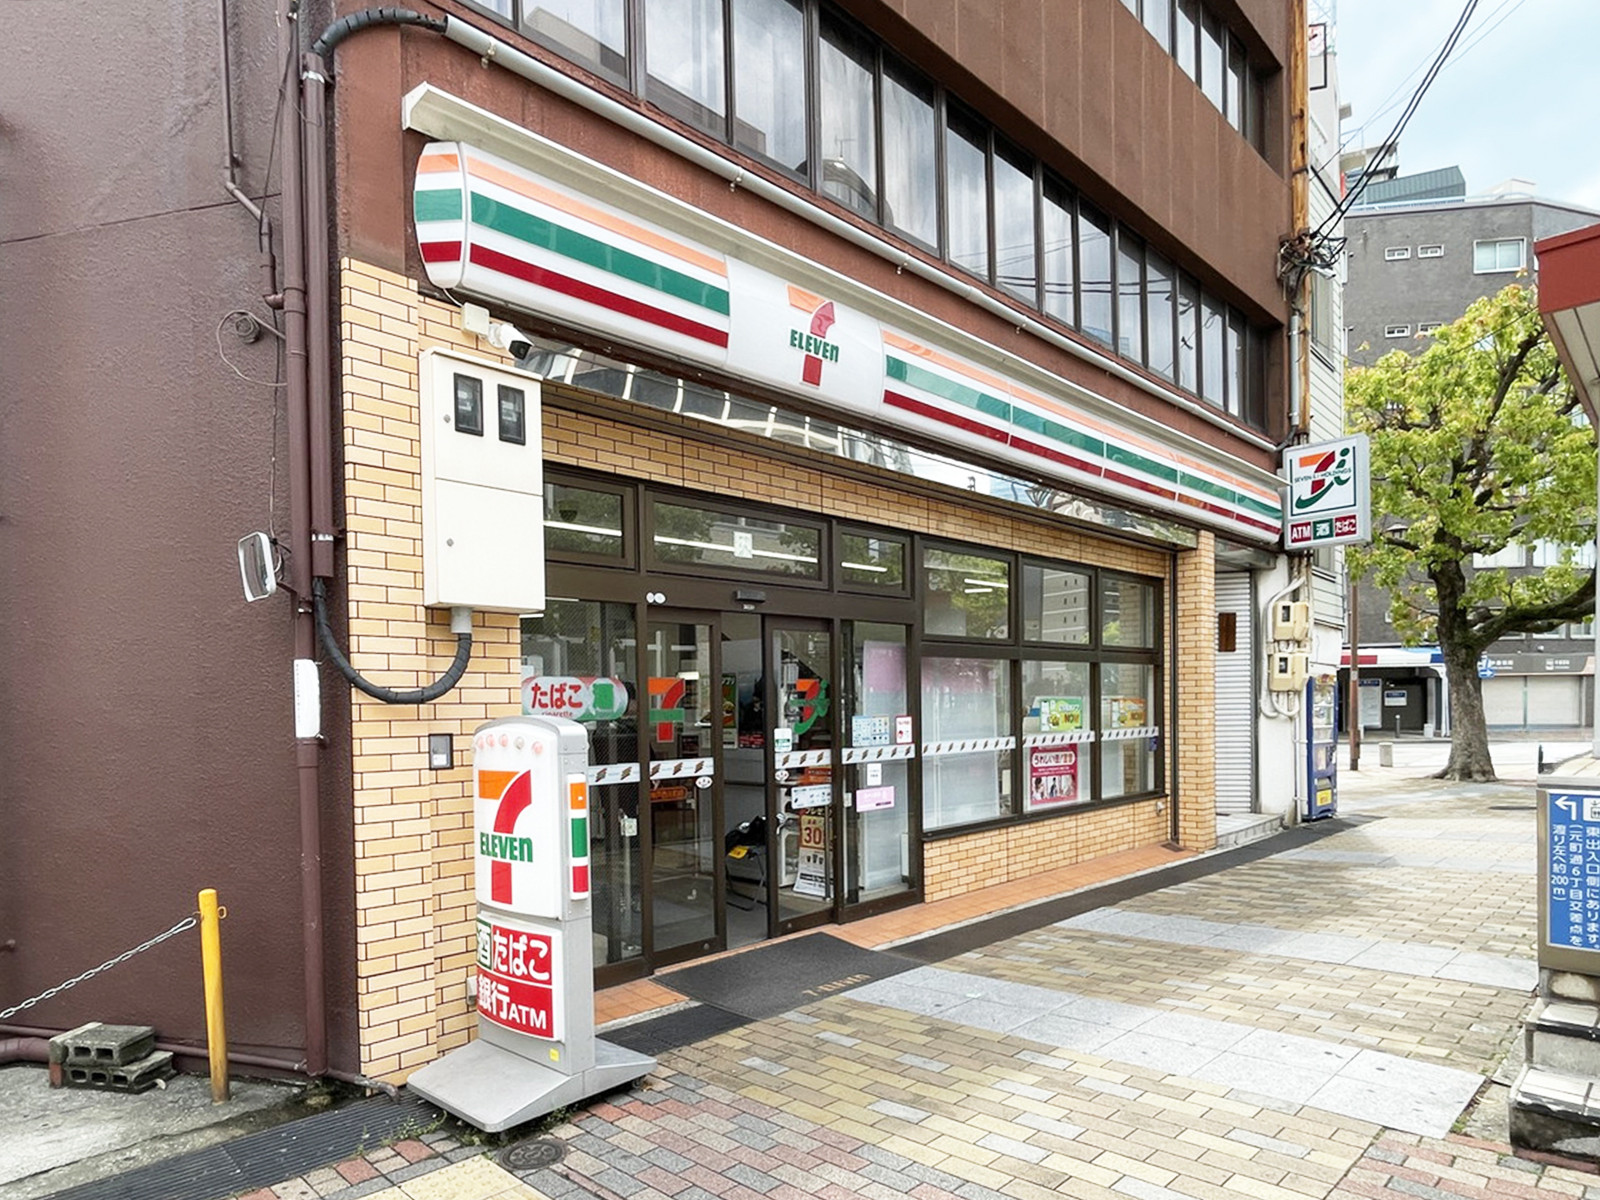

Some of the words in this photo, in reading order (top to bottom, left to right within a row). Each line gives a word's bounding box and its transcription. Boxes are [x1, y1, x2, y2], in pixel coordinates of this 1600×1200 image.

[1320, 467, 1352, 478] HOLDINGS
[1292, 525, 1311, 540] ATM
[1315, 521, 1331, 536] 酒
[1335, 518, 1356, 533] たばこ
[531, 682, 583, 709] たばこ
[478, 769, 532, 905] 7
[804, 826, 822, 846] 30
[493, 930, 551, 981] たばこ
[478, 974, 547, 1030] 銀行ATM
